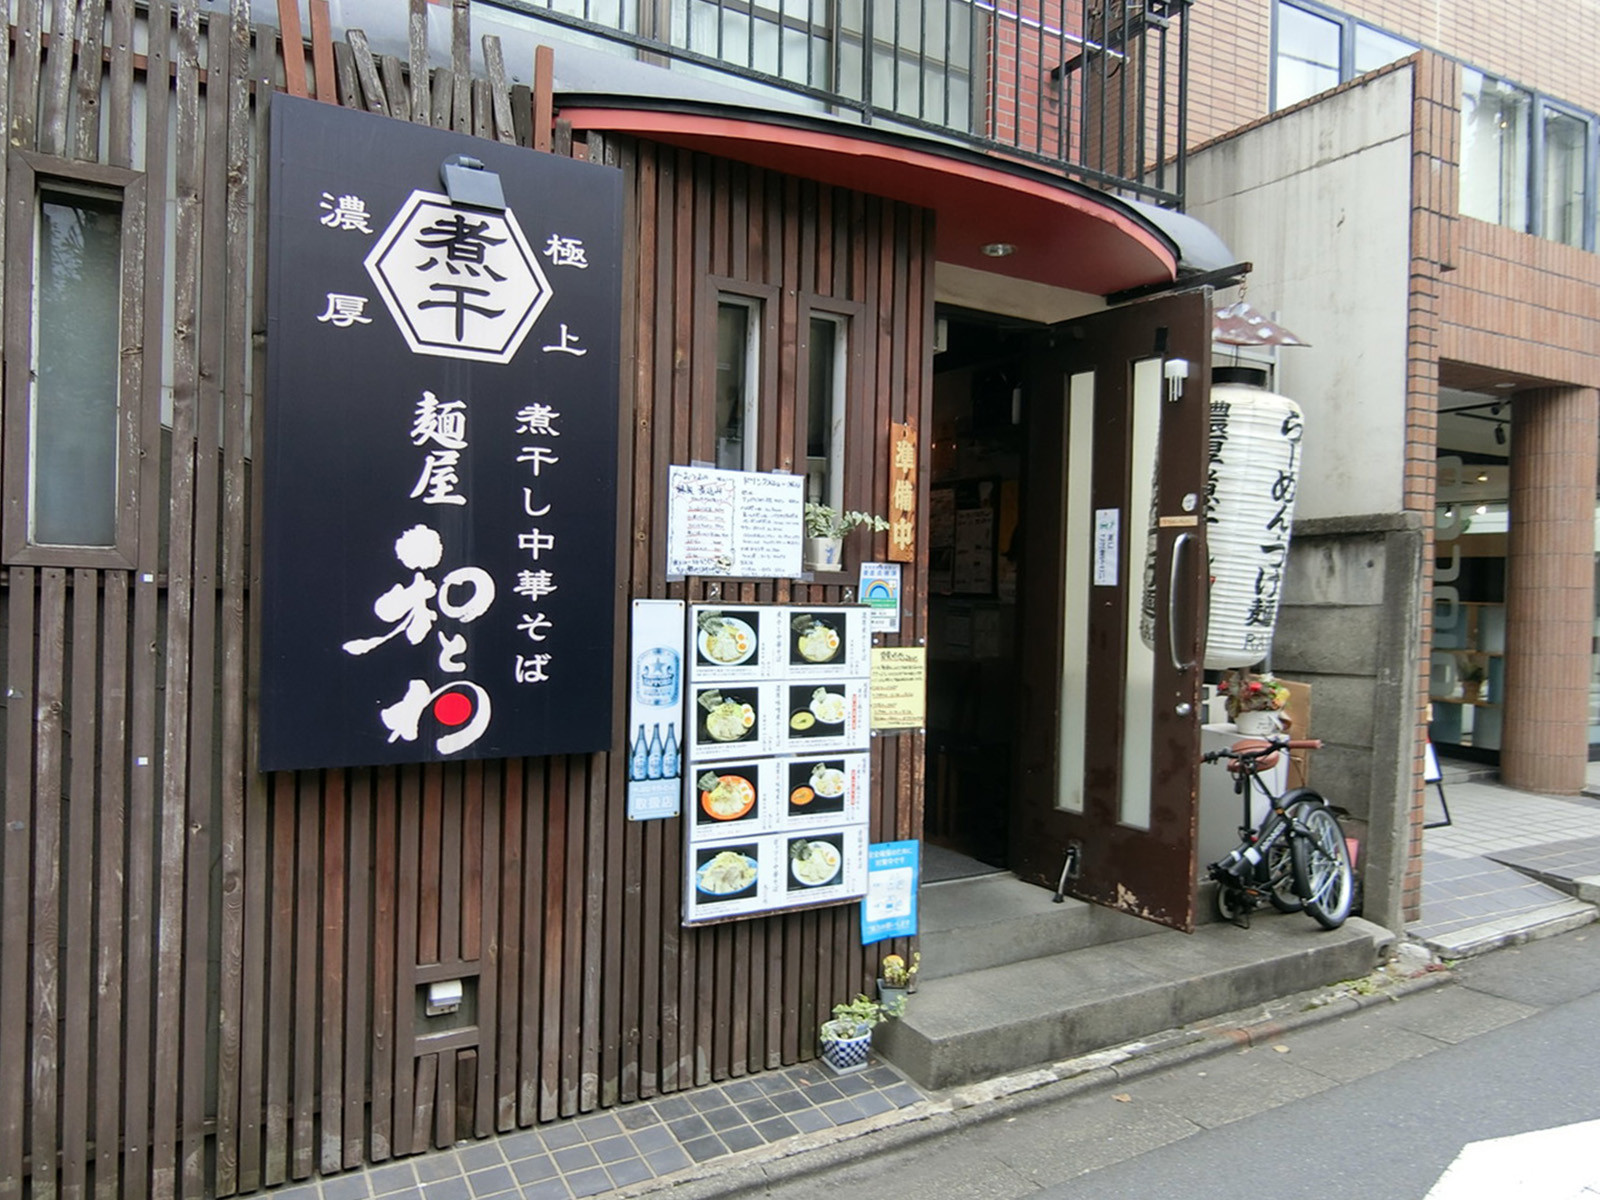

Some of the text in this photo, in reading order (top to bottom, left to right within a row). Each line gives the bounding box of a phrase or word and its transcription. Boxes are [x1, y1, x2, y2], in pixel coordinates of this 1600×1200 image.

[317, 192, 374, 327] 濃厚
[414, 214, 508, 342] 煮干
[542, 234, 589, 356] 極上
[513, 403, 561, 683] 煮干し中華そば
[893, 440, 915, 551] 準備中
[342, 391, 496, 755] 麺屋 和とわ
